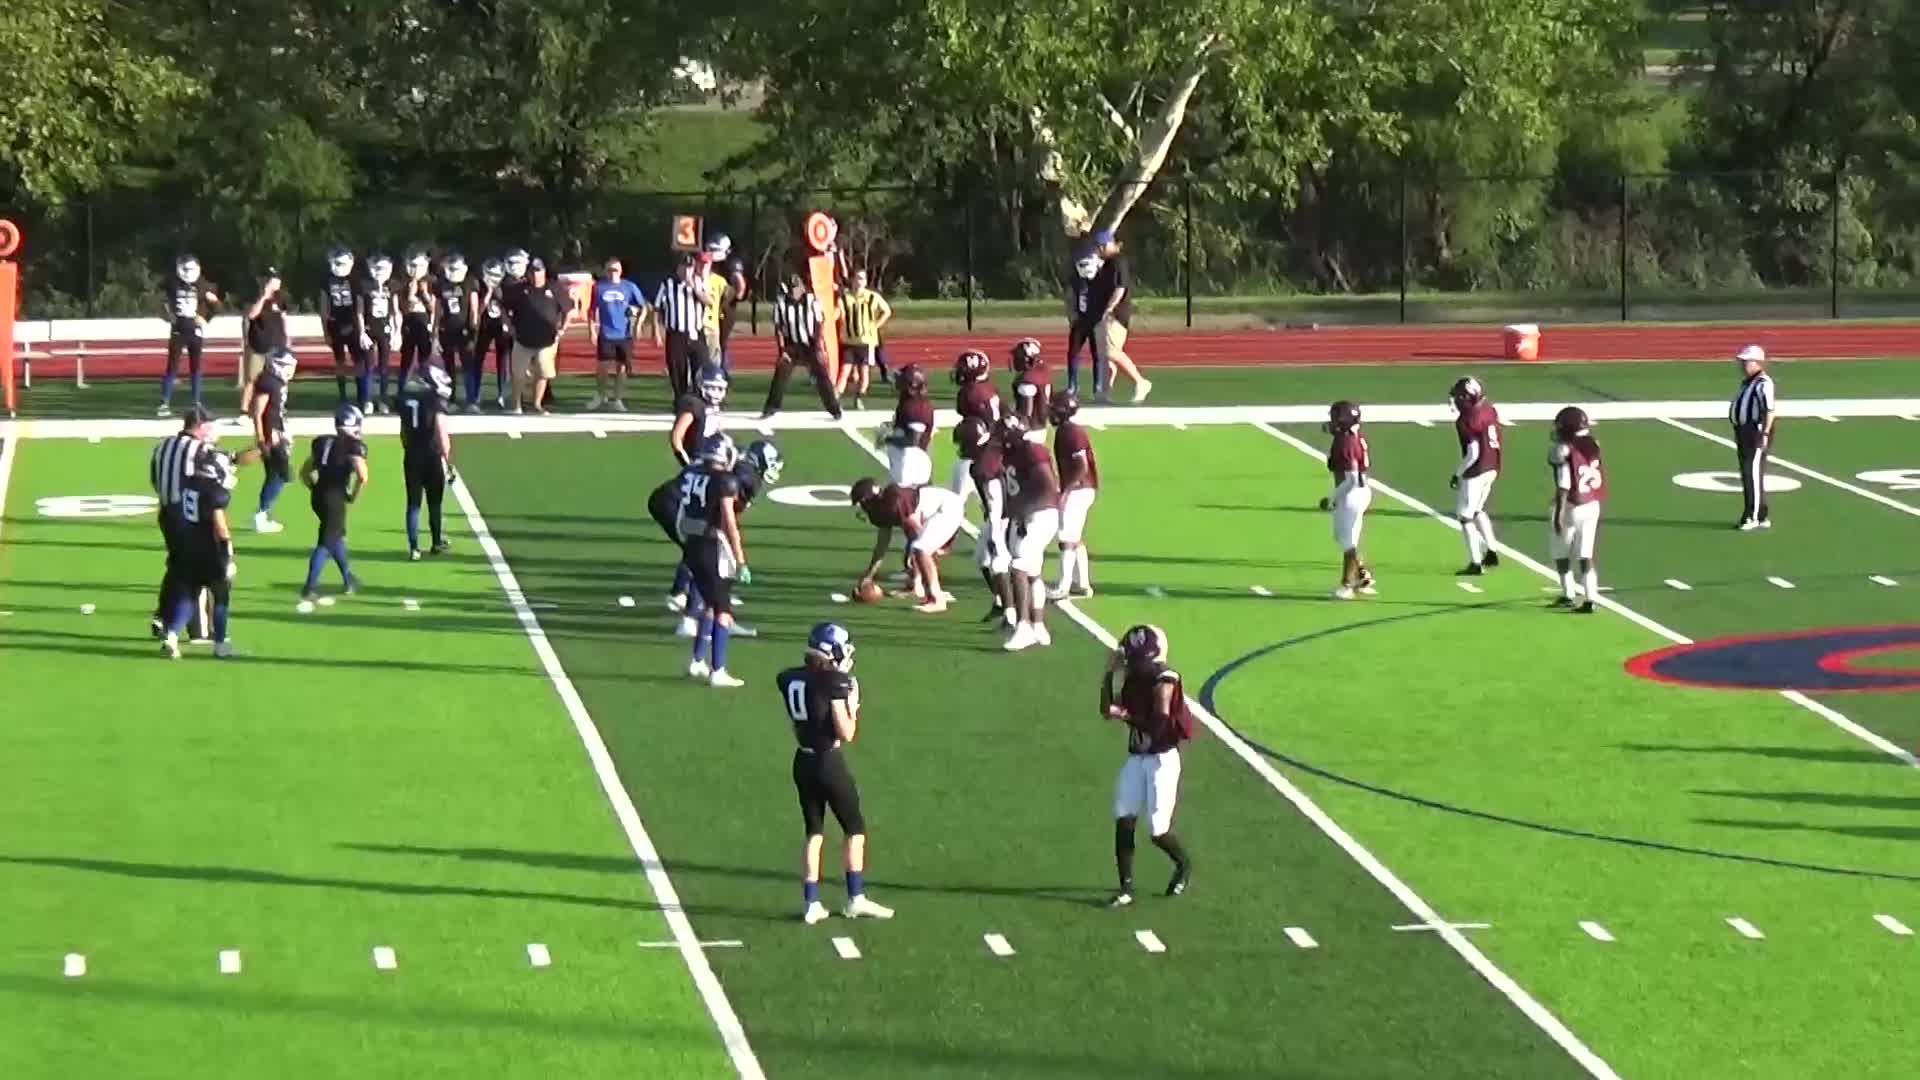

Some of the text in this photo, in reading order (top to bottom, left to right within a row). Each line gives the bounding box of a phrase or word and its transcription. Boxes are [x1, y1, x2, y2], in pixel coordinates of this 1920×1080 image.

[677, 216, 696, 246] 3
[405, 399, 419, 429] 7
[788, 680, 809, 721] 0
